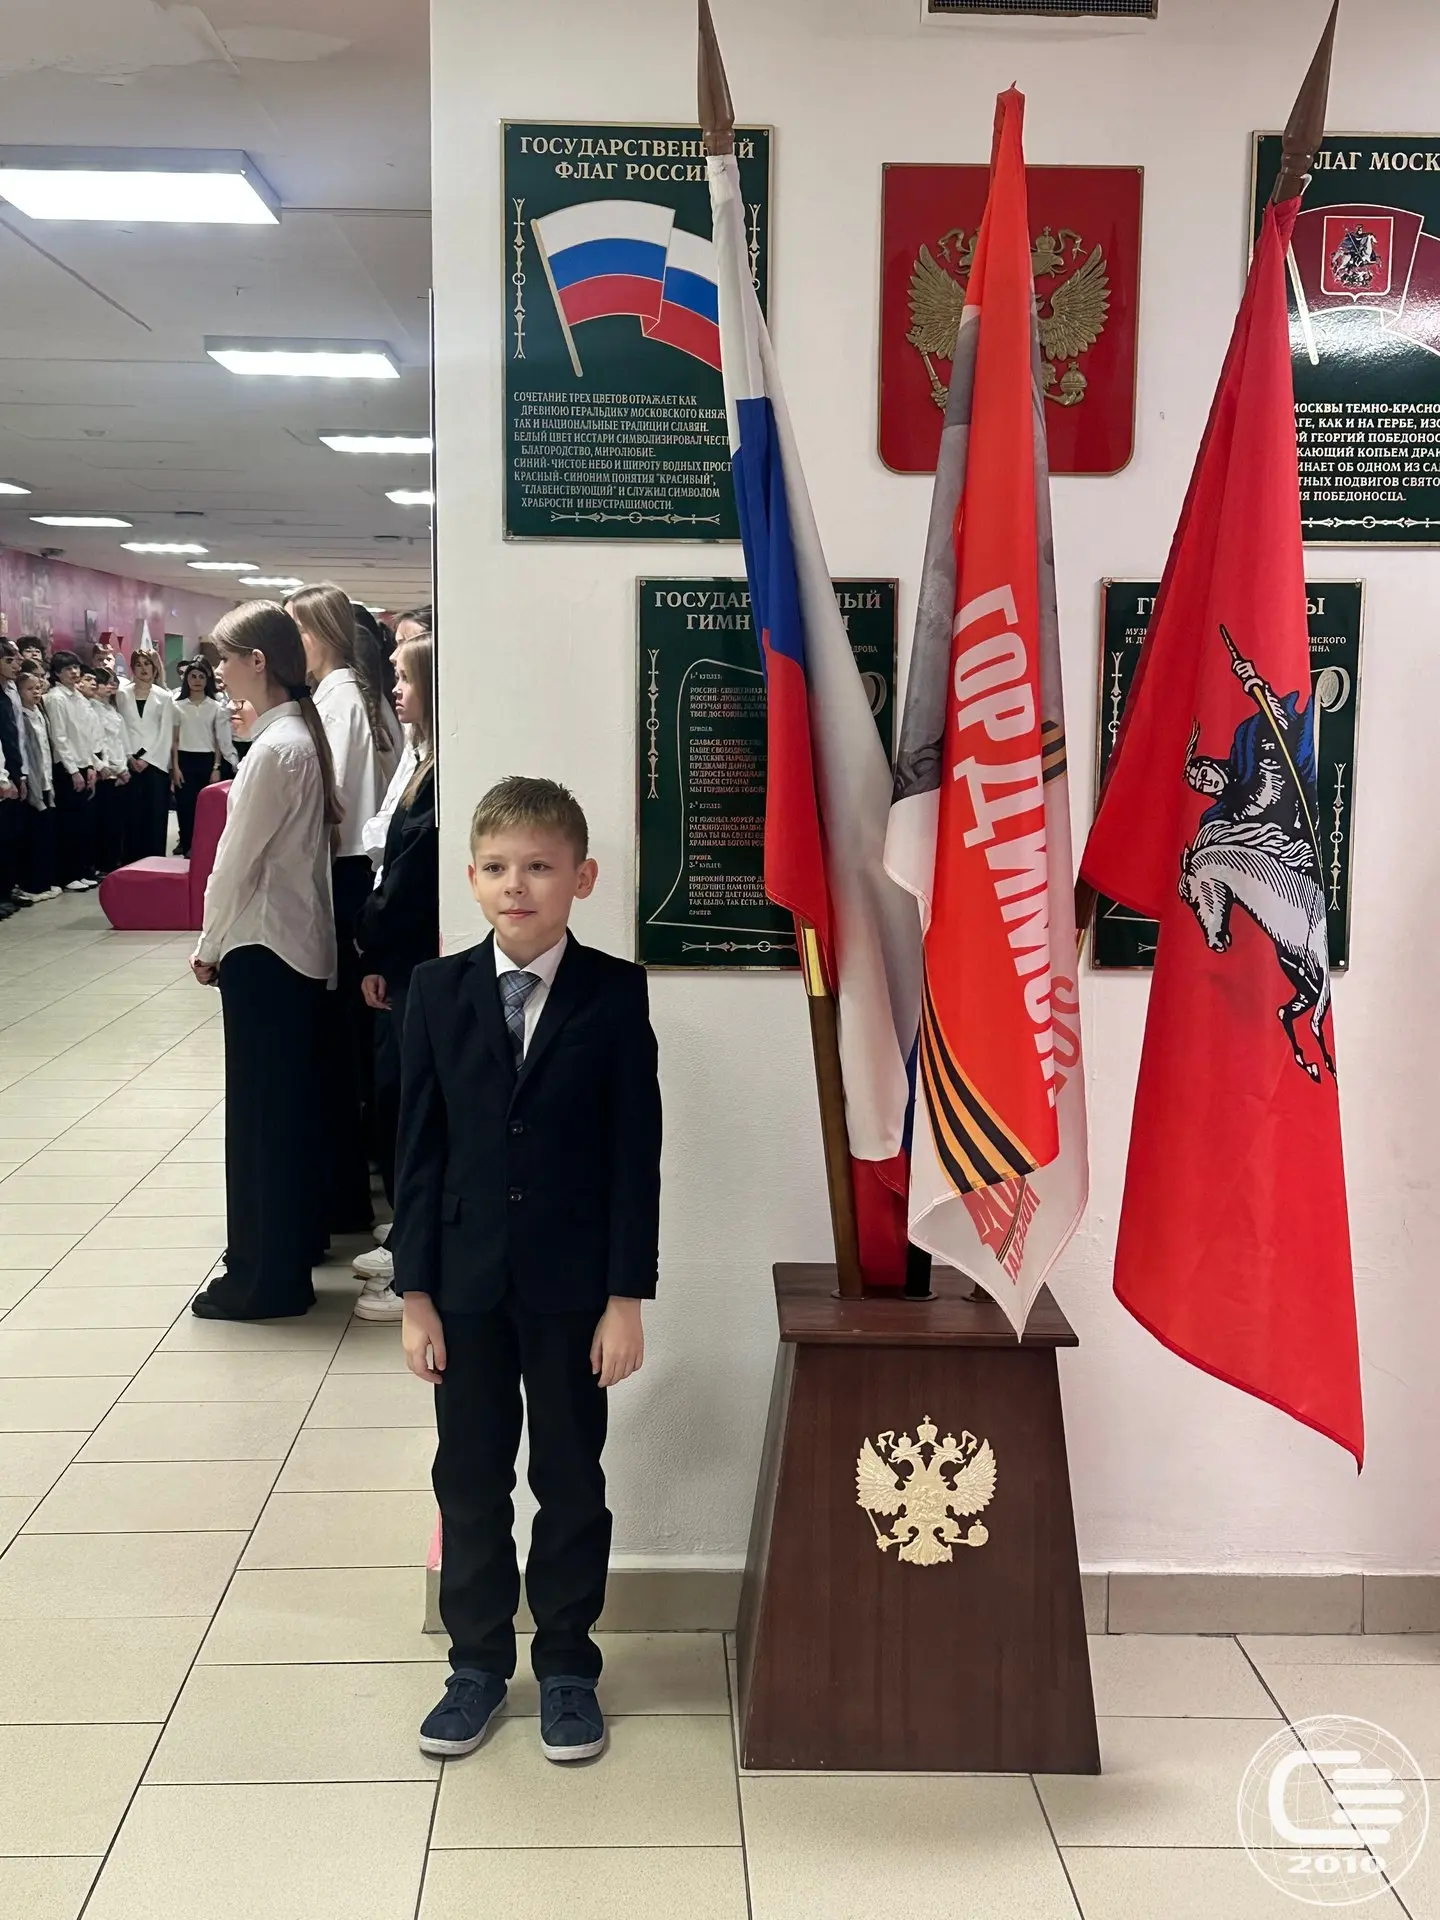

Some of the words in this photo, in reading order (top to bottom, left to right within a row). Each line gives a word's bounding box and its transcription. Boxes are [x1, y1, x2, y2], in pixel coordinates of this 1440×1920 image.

[1313, 151, 1362, 170] ЛАГ
[555, 161, 618, 179] ФЛАГ
[514, 392, 568, 403] СОЧЕТАНИЕ
[569, 392, 591, 403] ТРЕХ
[592, 393, 629, 404] ЦВЕТОВ
[629, 394, 678, 405] ОТРАЖАЕТ
[679, 395, 698, 406] КАК
[520, 405, 570, 416] ДРЕВНЮЮ
[571, 406, 629, 418] ГЕРАЛЬДИКУ
[630, 408, 697, 419] МОСКОВСКОГО
[514, 418, 532, 428] ТАК
[533, 418, 540, 429] И
[542, 419, 619, 430] НАЦИОНАЛЬНЫЕ
[620, 420, 669, 432] ТРАДИЦИИ
[670, 422, 710, 432] СЛАВЯН.
[1318, 418, 1343, 428] КАК
[1346, 418, 1355, 428] И
[1358, 418, 1375, 428] НА
[1377, 418, 1417, 430] ГЕРБЕ,
[514, 430, 547, 442] БЕЛЫЙ
[550, 432, 572, 443] ЦВЕТ
[616, 434, 702, 445] СИМВОЛИЗИРОВАЛ
[1310, 431, 1366, 442] ГЕОРГИЙ
[521, 445, 594, 458] БЛАГОРОДСТВО,
[594, 446, 656, 458] МИРОЛЮБИЕ.
[1358, 448, 1409, 458] КОПЬЕМ
[552, 458, 587, 469] ЧИСТОЕ
[588, 459, 613, 470] НЕБО
[614, 460, 622, 470] И
[622, 460, 660, 470] ШИРОТУ
[662, 461, 702, 472] ВОДНЫХ
[1338, 462, 1354, 472] ОБ
[1356, 462, 1401, 473] ОДНОМ
[1404, 462, 1420, 472] ИЗ
[564, 472, 611, 482] СИНОНИМ
[612, 473, 655, 484] ПОНЯТИЯ
[1334, 476, 1400, 488] ПОДВИГОВ
[618, 486, 625, 496] И
[626, 486, 667, 497] СЛУЖИЛ
[668, 487, 720, 498] СИМВОЛОМ
[1314, 491, 1407, 502] ПОБЕДОНОСЦА.
[521, 498, 574, 508] ХРАБРОСТИ
[577, 498, 584, 508] И
[585, 498, 674, 510] НЕУСТРАШИМОСТИ.
[686, 614, 751, 630] ГИМН
